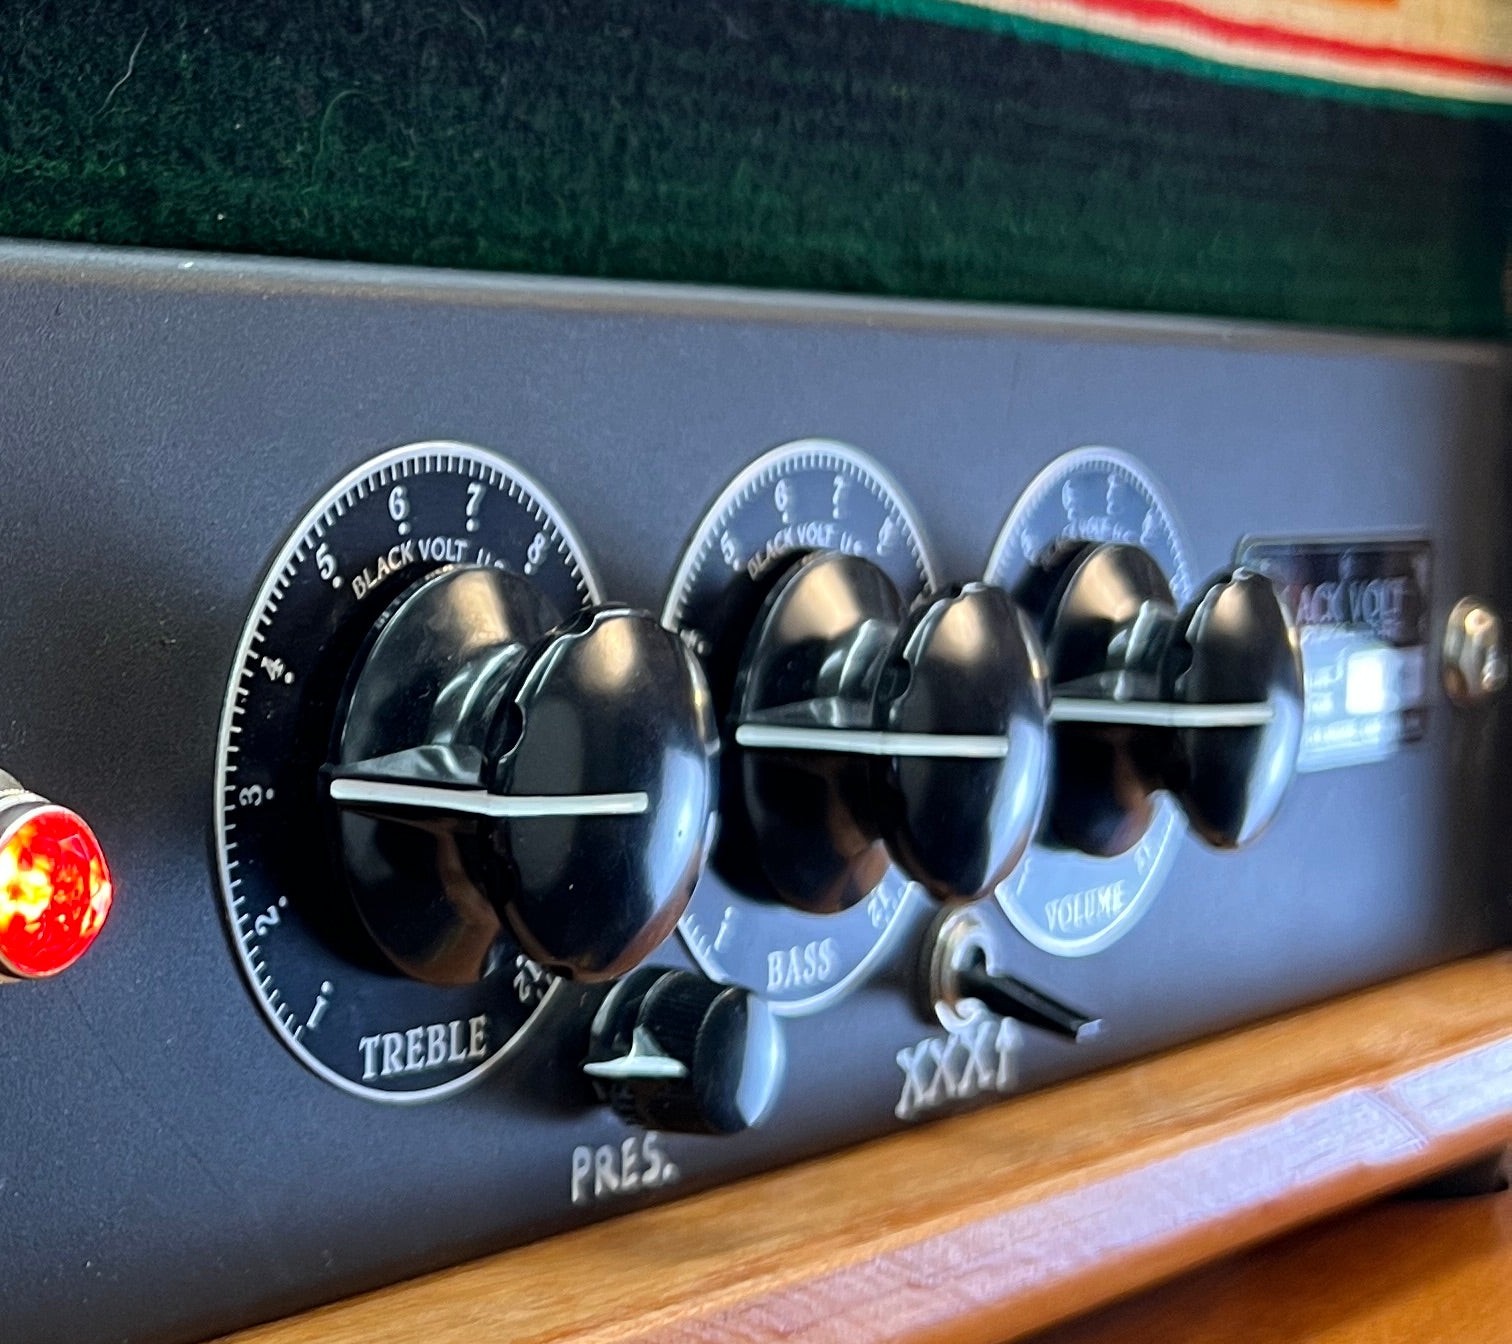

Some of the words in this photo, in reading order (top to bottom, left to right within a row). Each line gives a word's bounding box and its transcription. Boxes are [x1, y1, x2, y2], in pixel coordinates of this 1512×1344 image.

[389, 484, 409, 521] 6
[466, 482, 486, 517] 7
[527, 532, 549, 564] 8
[796, 521, 836, 546] VOLT
[316, 543, 336, 580] 5
[351, 537, 415, 600] BLACK
[418, 536, 469, 562] VOLT
[260, 656, 285, 682] 4
[239, 785, 261, 806] 3
[254, 905, 281, 936] 2
[1044, 880, 1126, 933] VOLUME
[767, 937, 838, 994] BASS
[358, 1013, 488, 1082] TREBLE
[571, 1130, 680, 1206] PRES.
